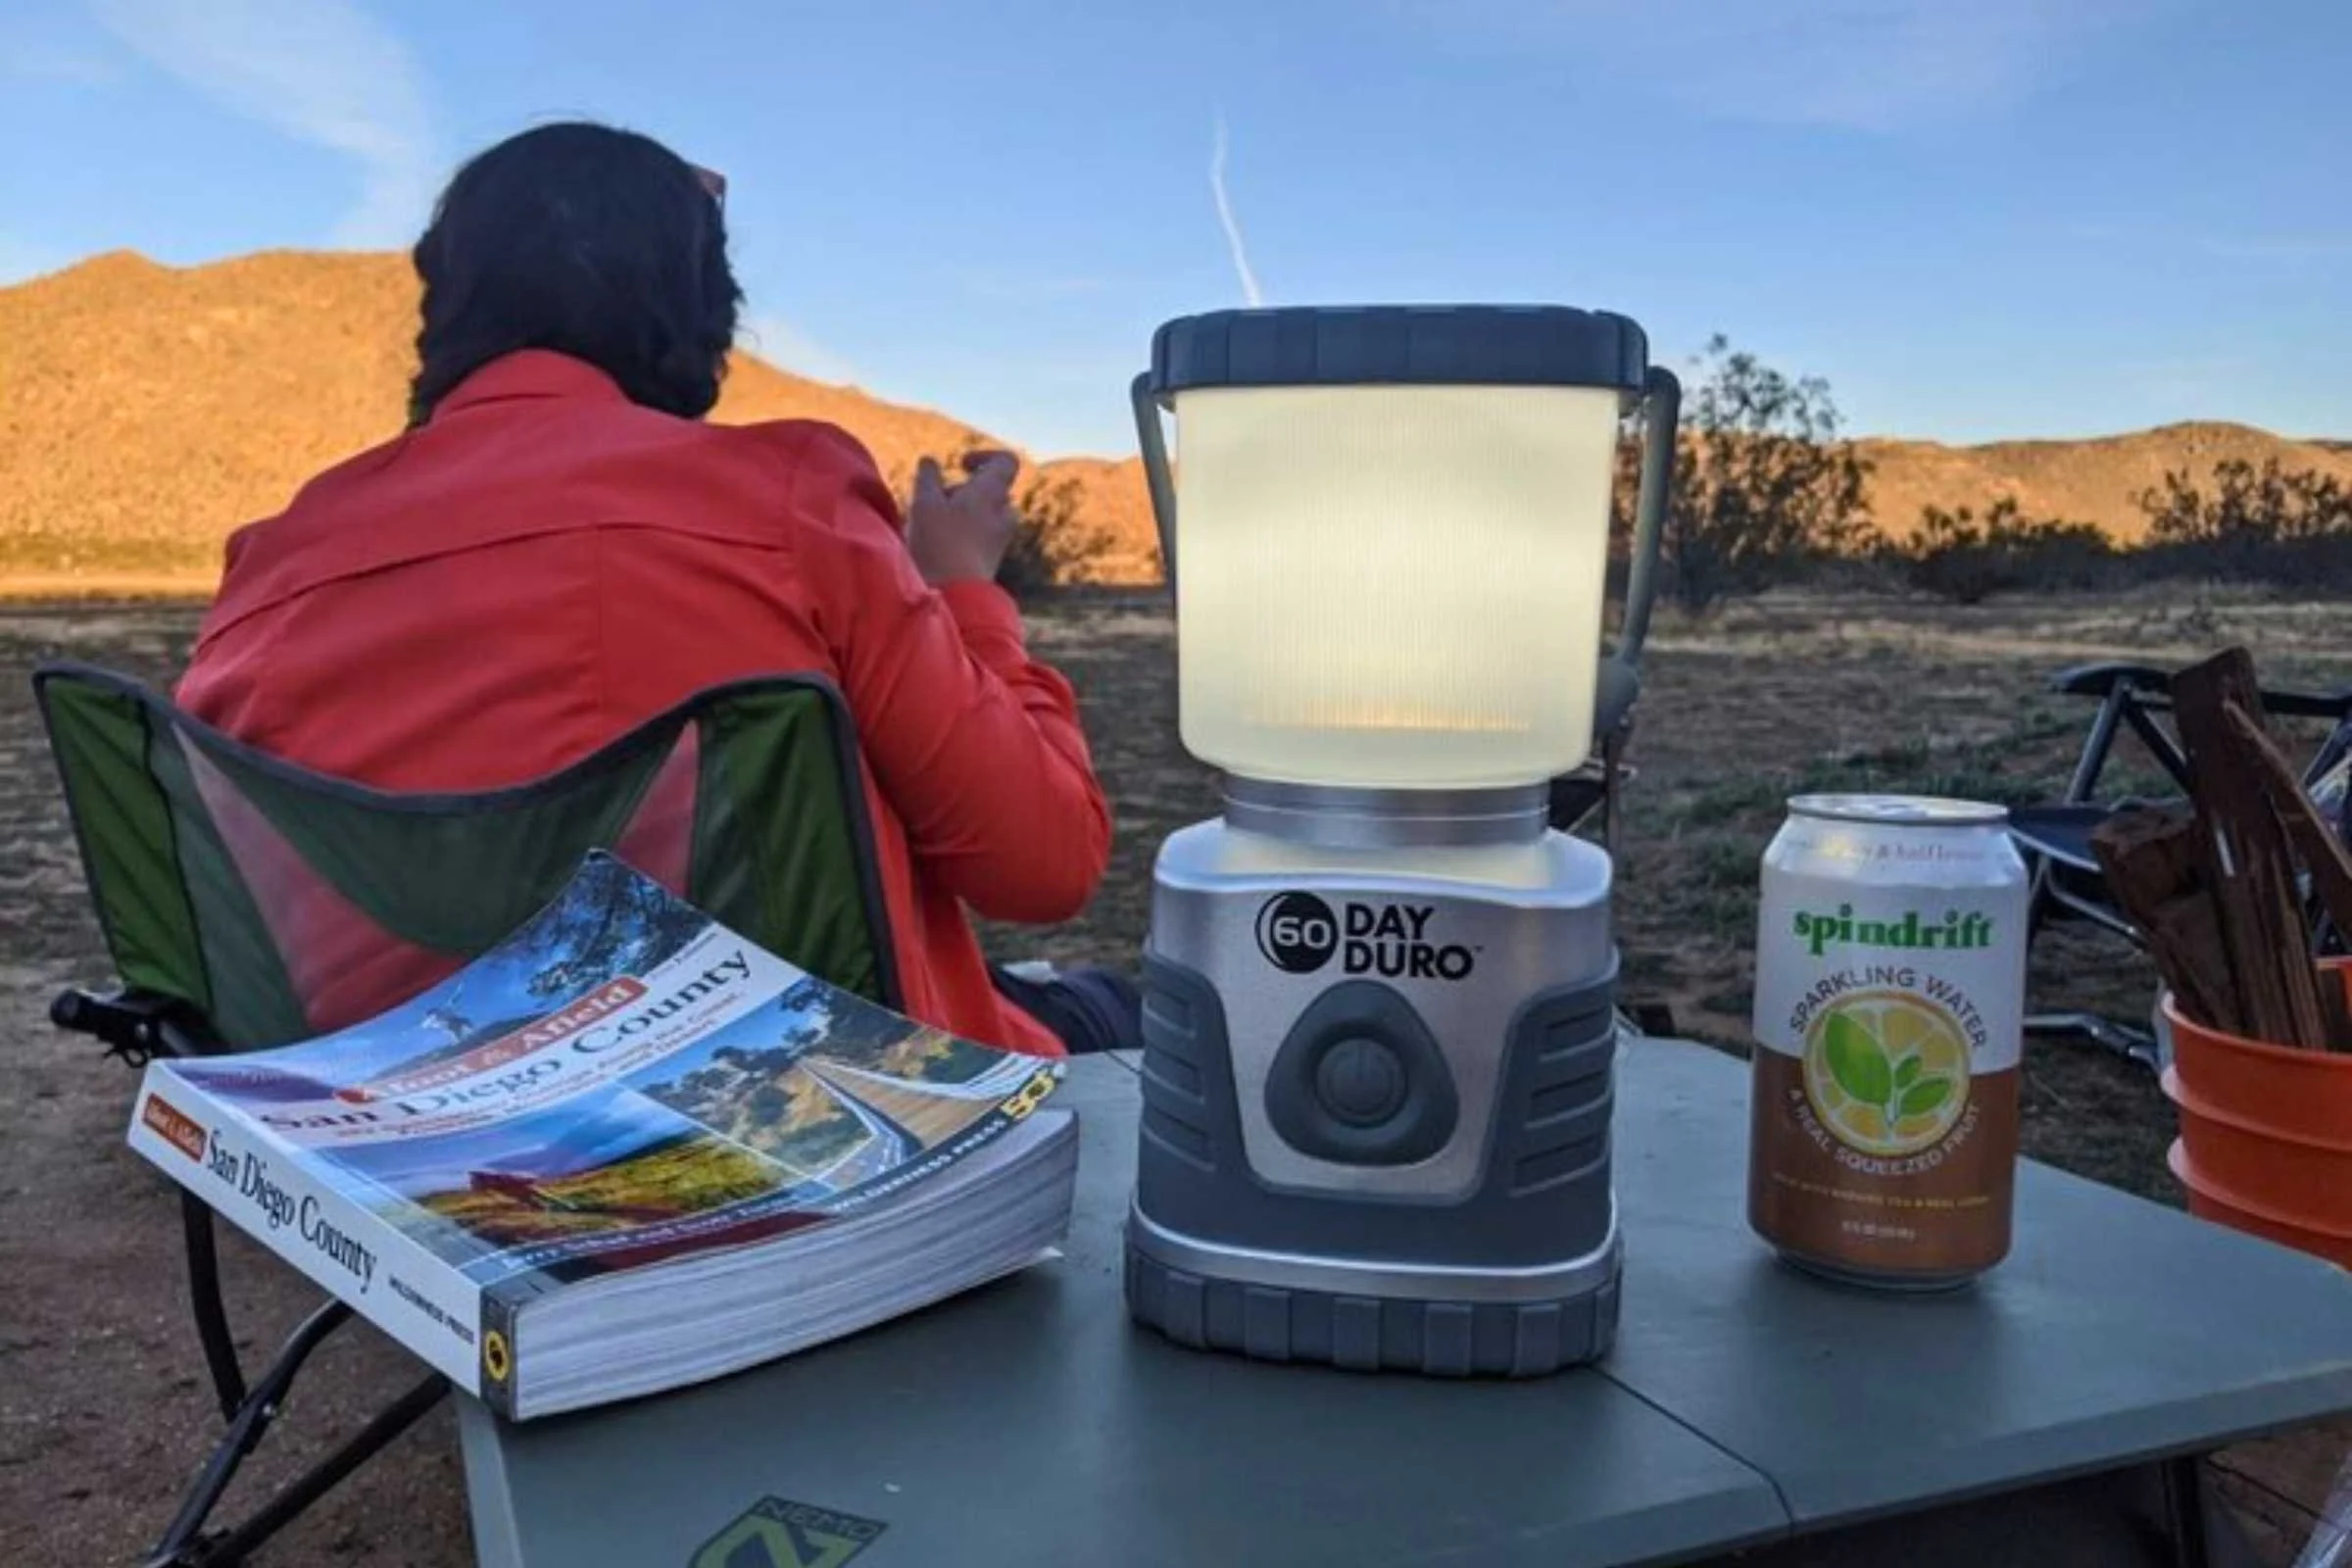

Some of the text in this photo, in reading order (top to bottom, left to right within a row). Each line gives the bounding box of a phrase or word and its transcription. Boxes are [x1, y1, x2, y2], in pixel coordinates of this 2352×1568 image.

[1274, 903, 1435, 949] 60 DAY
[1793, 903, 1993, 956] spindrift
[396, 1058, 563, 1115] Diego
[571, 948, 752, 1055] County
[520, 984, 633, 1052] Afield
[1789, 964, 1987, 1048] SPARKLING WATER
[208, 1129, 239, 1186] San
[240, 1152, 295, 1230] Diego
[300, 1195, 377, 1294] County
